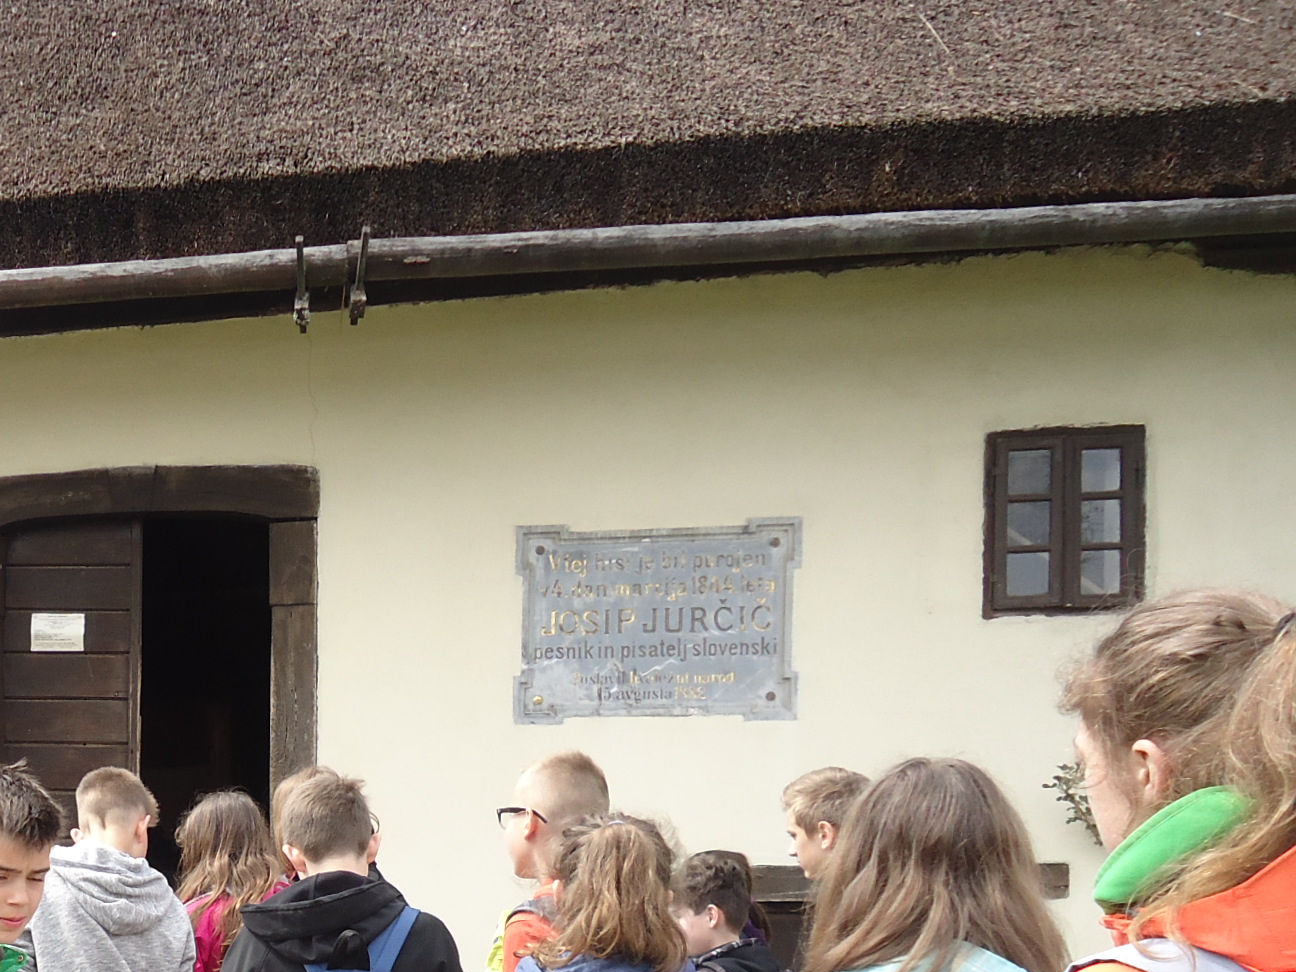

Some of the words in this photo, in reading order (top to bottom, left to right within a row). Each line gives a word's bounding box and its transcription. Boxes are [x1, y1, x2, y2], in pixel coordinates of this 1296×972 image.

[635, 555, 654, 576] je
[541, 607, 637, 636] JOSIP
[533, 641, 594, 661] pesnik
[597, 643, 615, 660] in
[620, 638, 688, 664] pisatelj
[692, 636, 778, 658] slovenski
